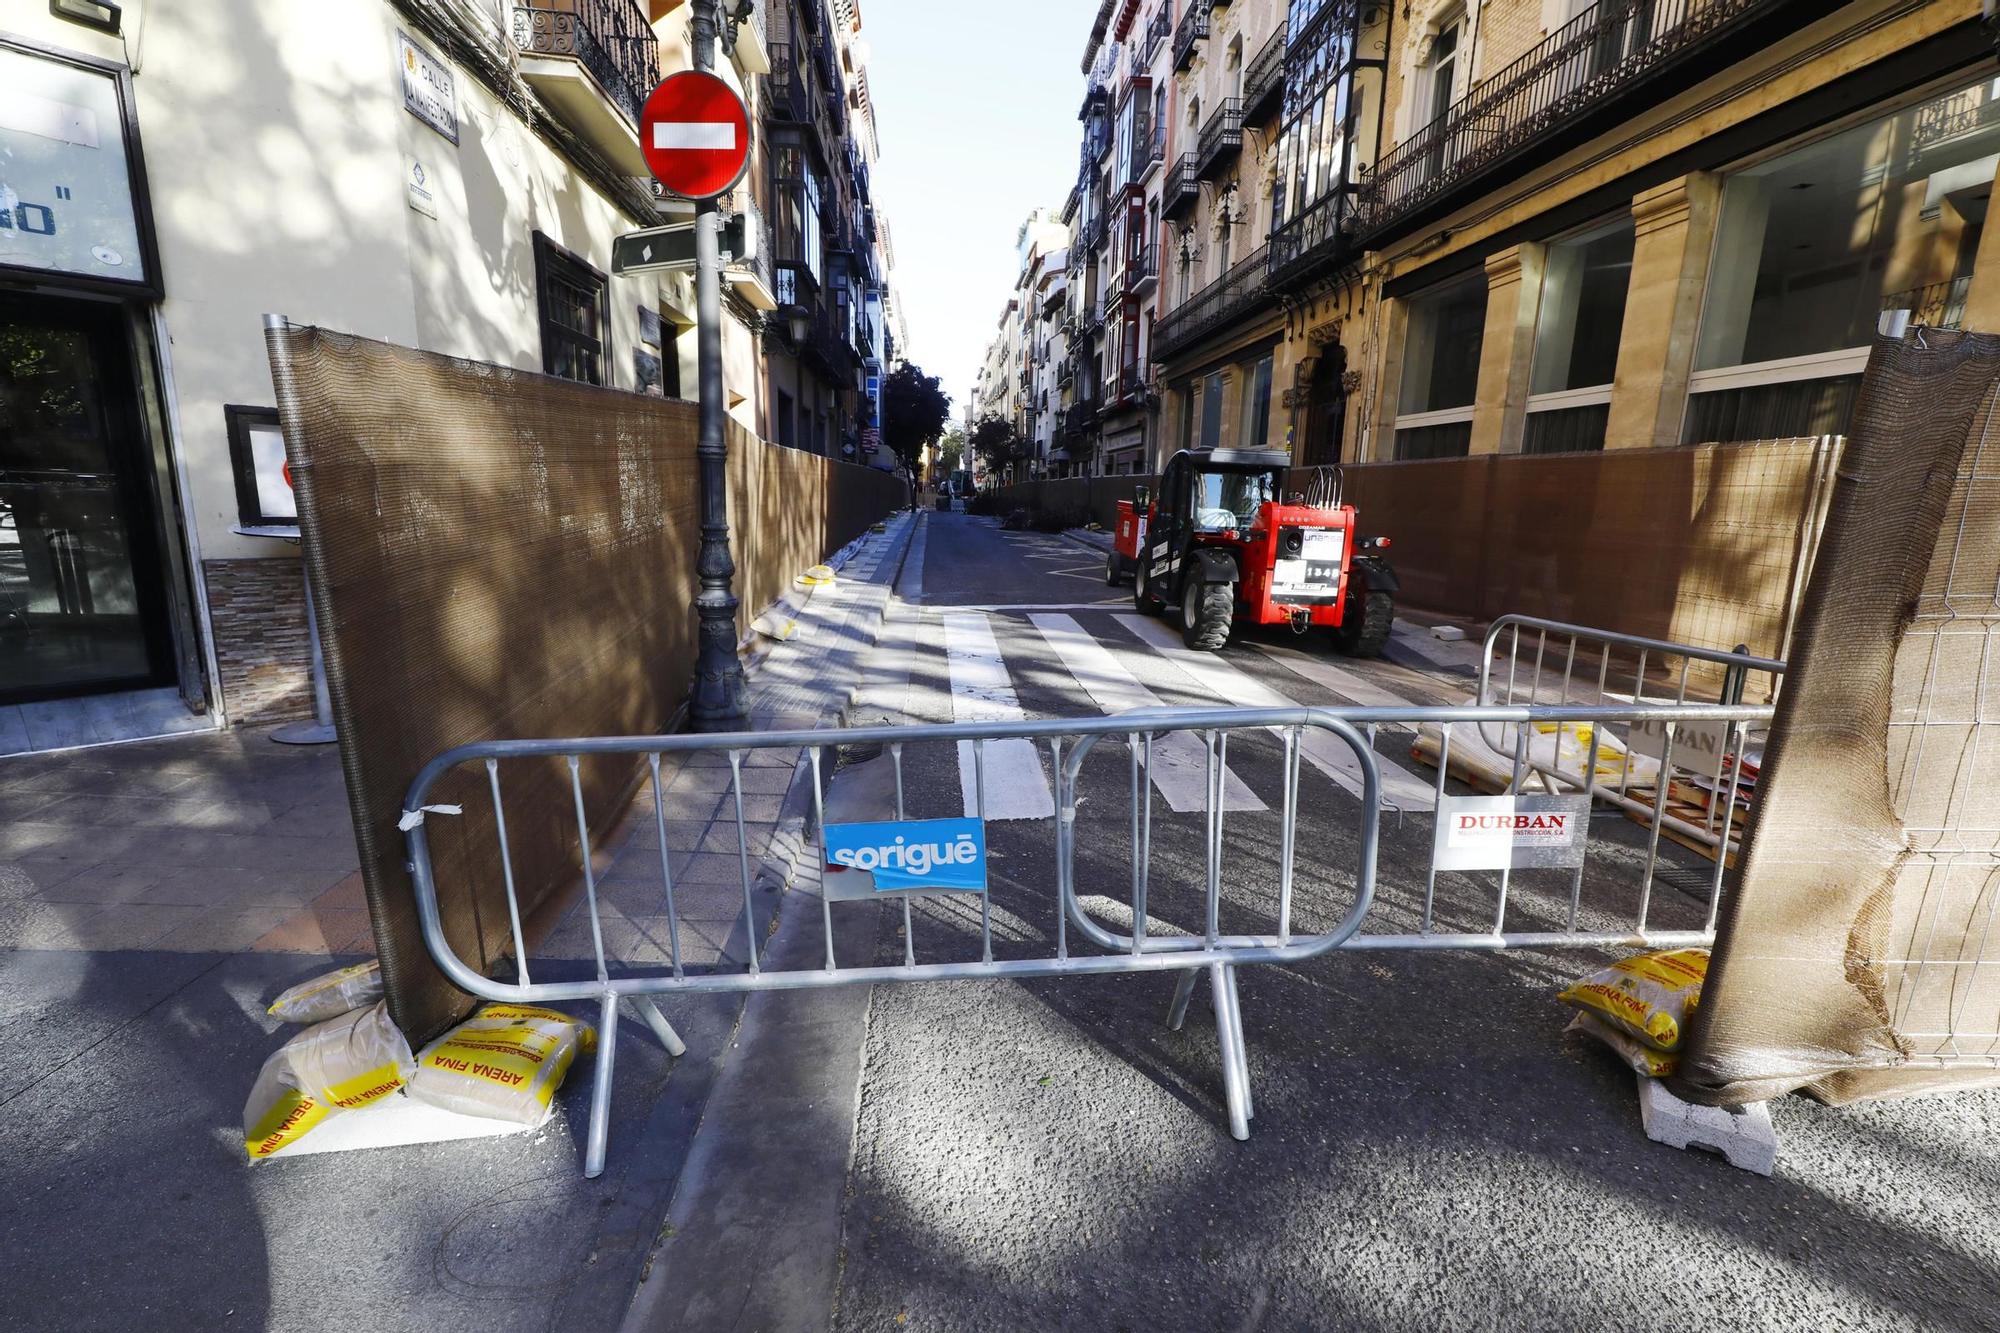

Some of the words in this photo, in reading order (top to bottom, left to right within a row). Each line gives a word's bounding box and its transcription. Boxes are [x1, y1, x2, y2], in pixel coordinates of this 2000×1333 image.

[421, 64, 450, 98] CALLE
[1458, 815, 1567, 829] DURBAN
[1582, 984, 1621, 1002] ARENA
[434, 1056, 468, 1073] FINA
[472, 1063, 525, 1086] ARENA
[360, 1079, 401, 1100] ARENA
[334, 1095, 362, 1108] FINA
[279, 1096, 314, 1131] RENA
[256, 1131, 284, 1155] FINA
